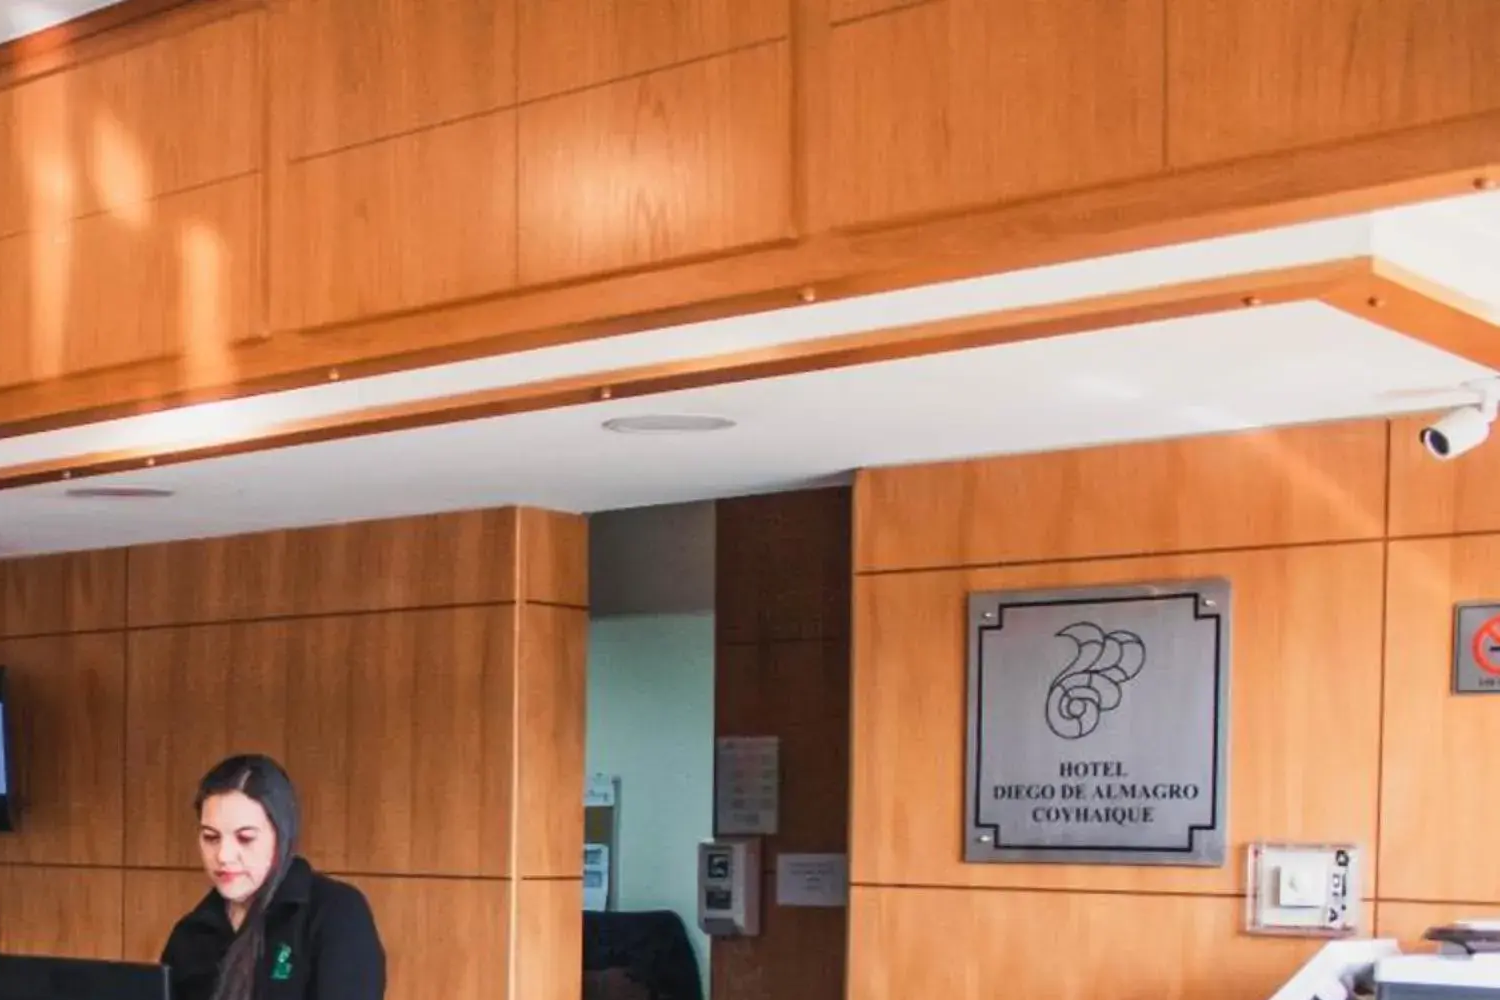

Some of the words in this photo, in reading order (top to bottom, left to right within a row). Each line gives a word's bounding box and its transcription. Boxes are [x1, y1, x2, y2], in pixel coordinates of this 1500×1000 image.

[1059, 761, 1128, 777] HOTEL
[993, 784, 1056, 800] DIEGO
[1061, 784, 1083, 799] DE
[1092, 783, 1199, 799] ALMAGRO
[1032, 806, 1155, 825] COYHAIQUE
